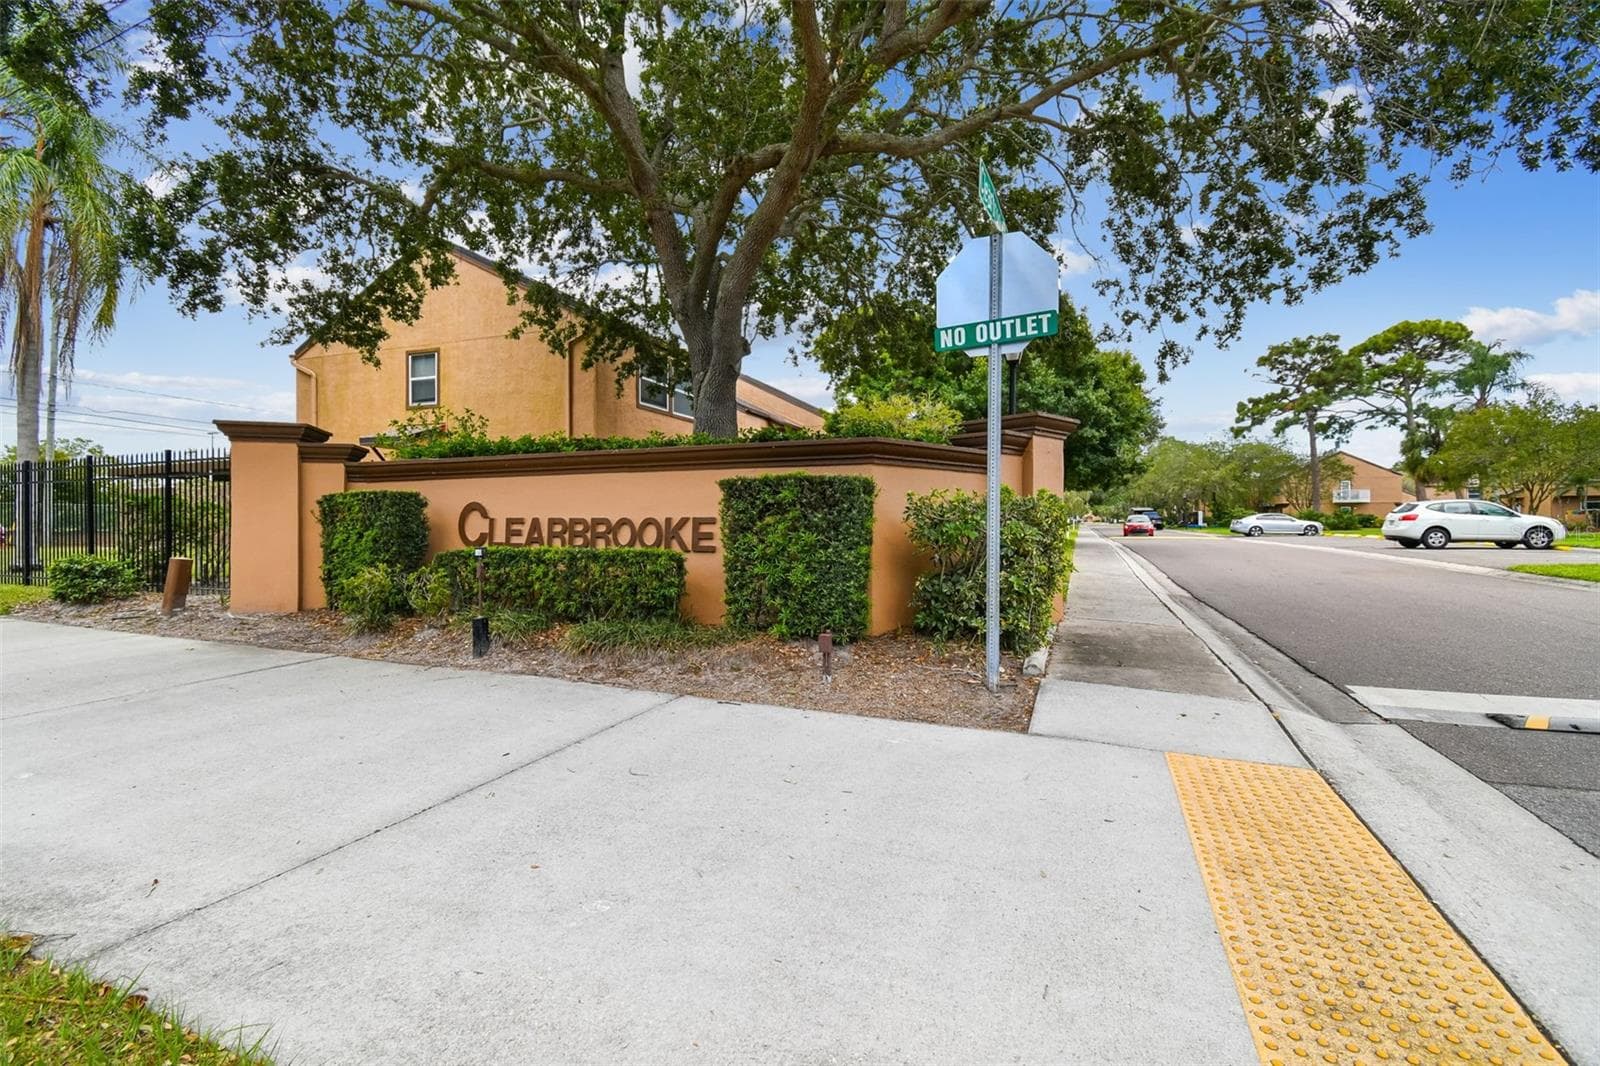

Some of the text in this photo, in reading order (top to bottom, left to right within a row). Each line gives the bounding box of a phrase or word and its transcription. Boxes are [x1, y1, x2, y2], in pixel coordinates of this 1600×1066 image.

[940, 313, 1051, 349] NO OUTLET
[458, 501, 717, 553] CLEARBROOKE
